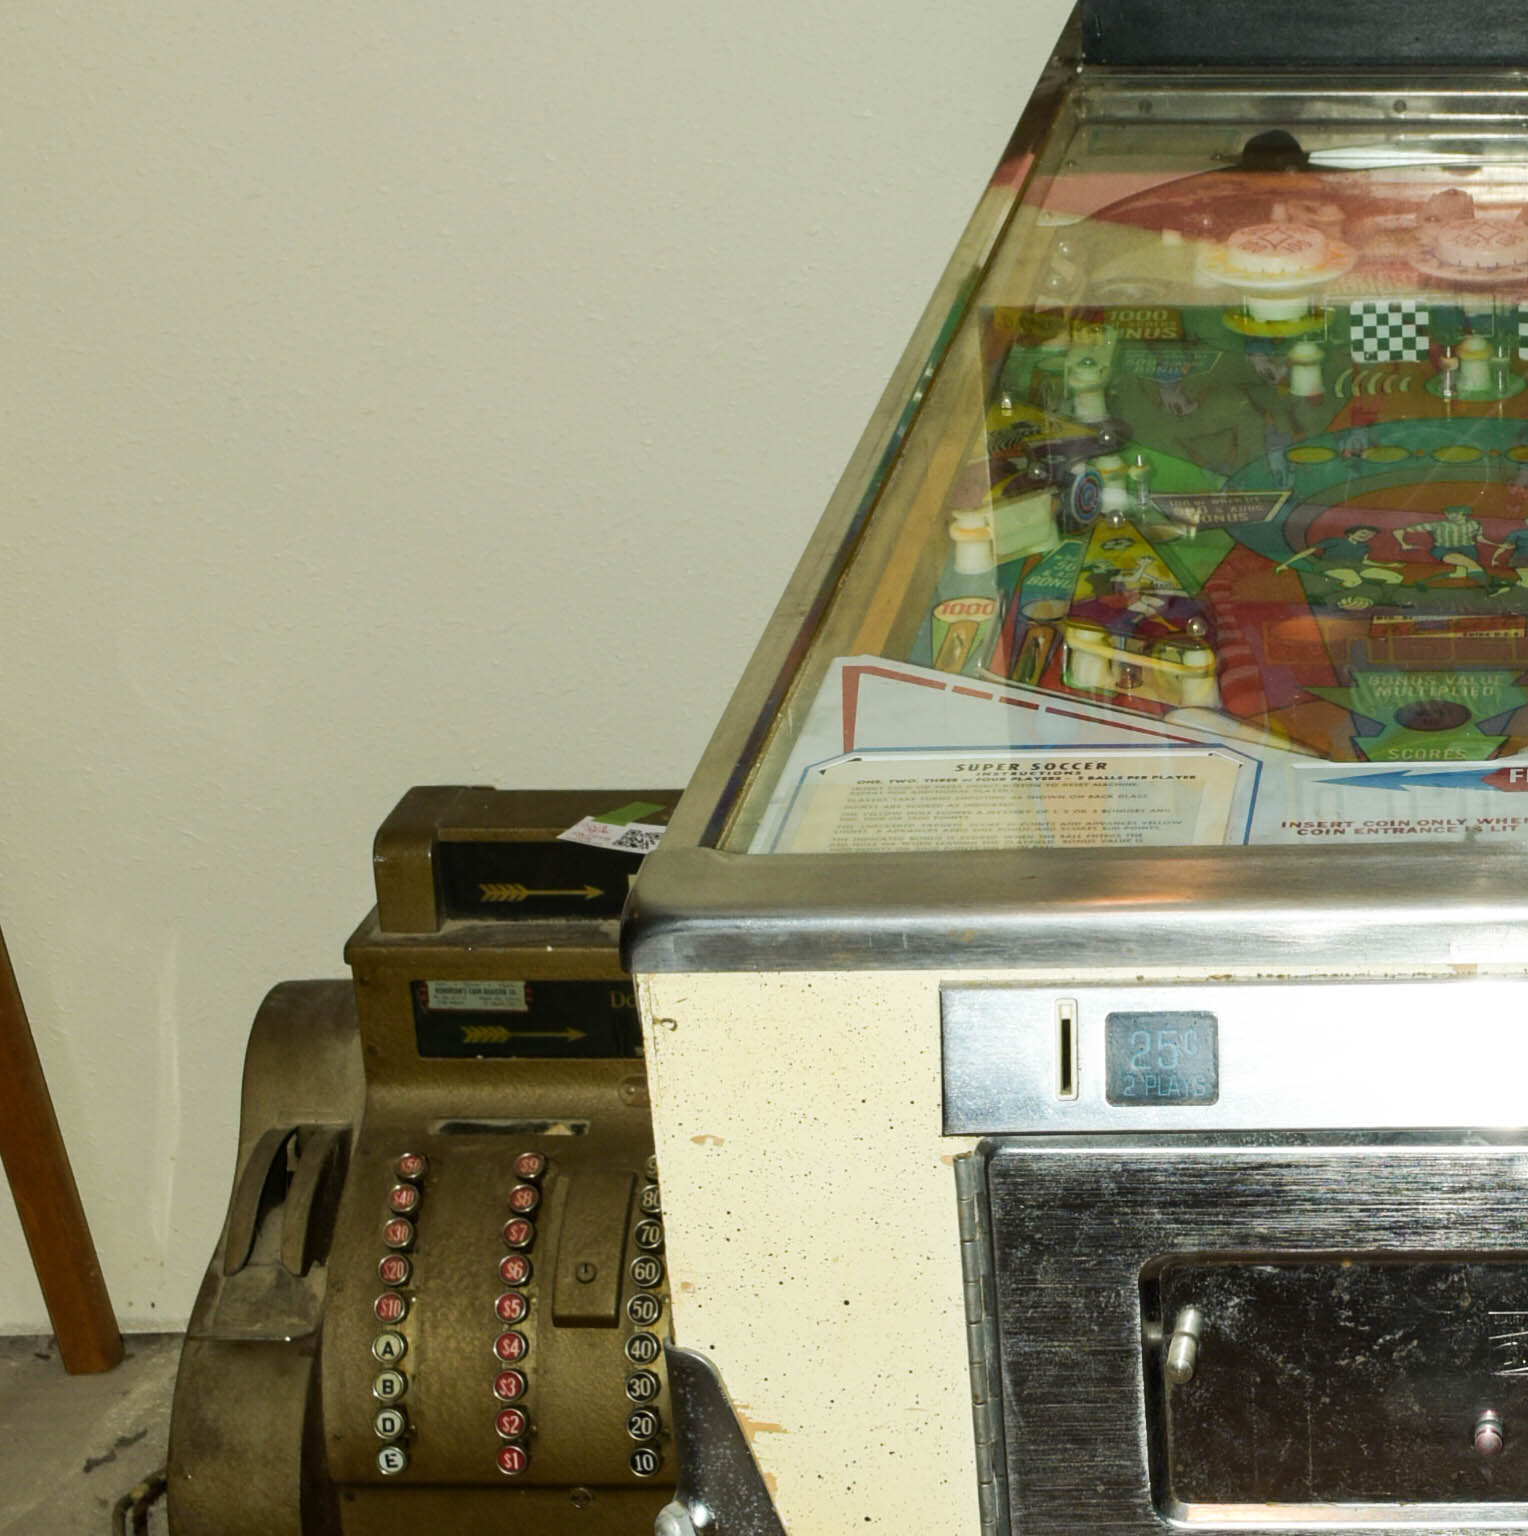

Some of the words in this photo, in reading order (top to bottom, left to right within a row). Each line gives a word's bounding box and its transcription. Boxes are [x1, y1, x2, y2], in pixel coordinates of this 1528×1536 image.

[1387, 748, 1468, 761] SCORES
[954, 763, 1021, 773] SUPER
[1031, 762, 1108, 771] SOCCER
[1281, 821, 1354, 829] INSERT
[1363, 820, 1411, 828] COIN
[1417, 818, 1468, 827] ONLY
[1354, 826, 1457, 835] ENTRANCE
[1489, 824, 1519, 833] LIT
[1123, 1074, 1137, 1096] 2
[1144, 1074, 1207, 1097] PLAYS
[640, 1225, 660, 1243] 70
[634, 1262, 656, 1280] 60
[503, 1298, 522, 1318] $5
[632, 1300, 653, 1319] 50
[381, 1341, 395, 1356] A
[502, 1337, 520, 1356] $4
[630, 1340, 651, 1359] 40
[382, 1379, 395, 1395] B
[499, 1377, 516, 1397] $3
[630, 1377, 651, 1397] 30
[382, 1417, 395, 1433] D
[502, 1415, 519, 1433] $2
[631, 1416, 652, 1435] 20
[384, 1453, 399, 1469] E
[503, 1451, 519, 1470] $1
[634, 1454, 654, 1471] 10
